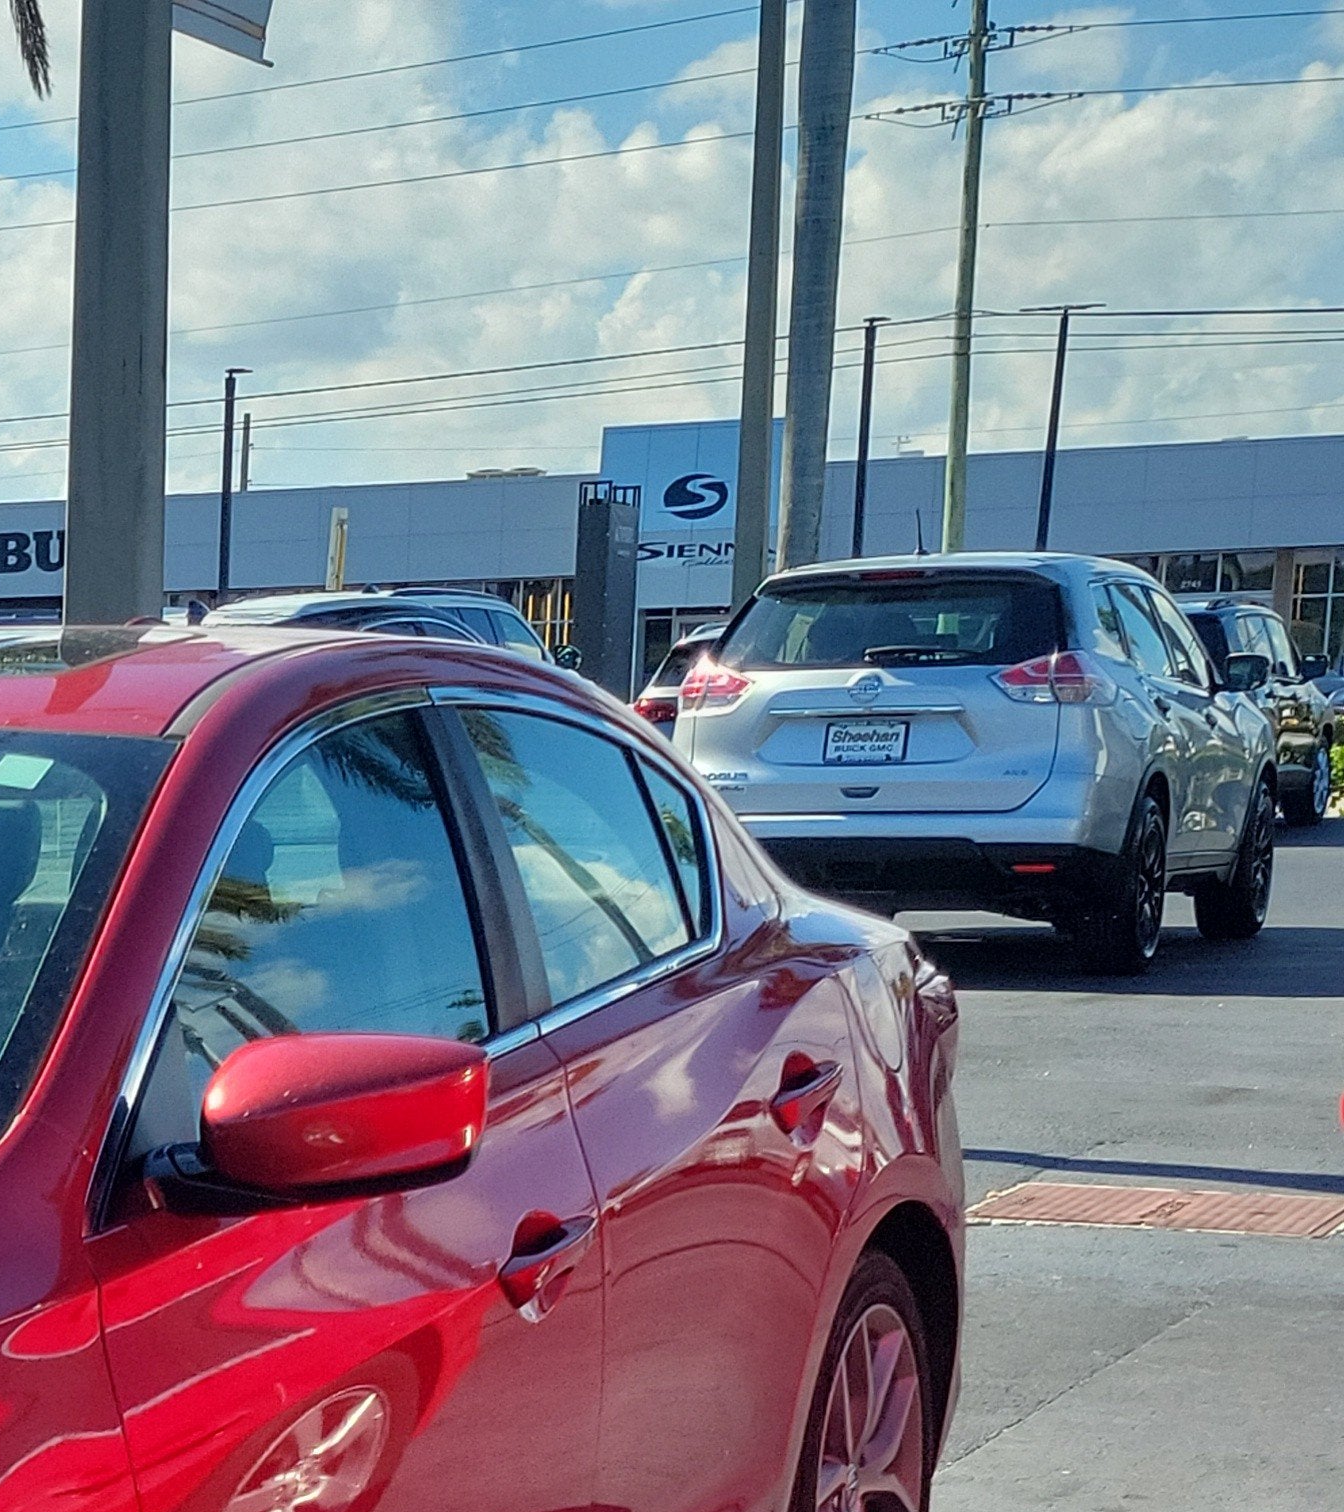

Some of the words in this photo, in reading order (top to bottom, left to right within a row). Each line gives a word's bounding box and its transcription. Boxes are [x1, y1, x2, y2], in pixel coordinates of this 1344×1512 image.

[831, 729, 900, 743] Sheehan
[834, 744, 866, 752] BUICK
[869, 744, 894, 752] GMC
